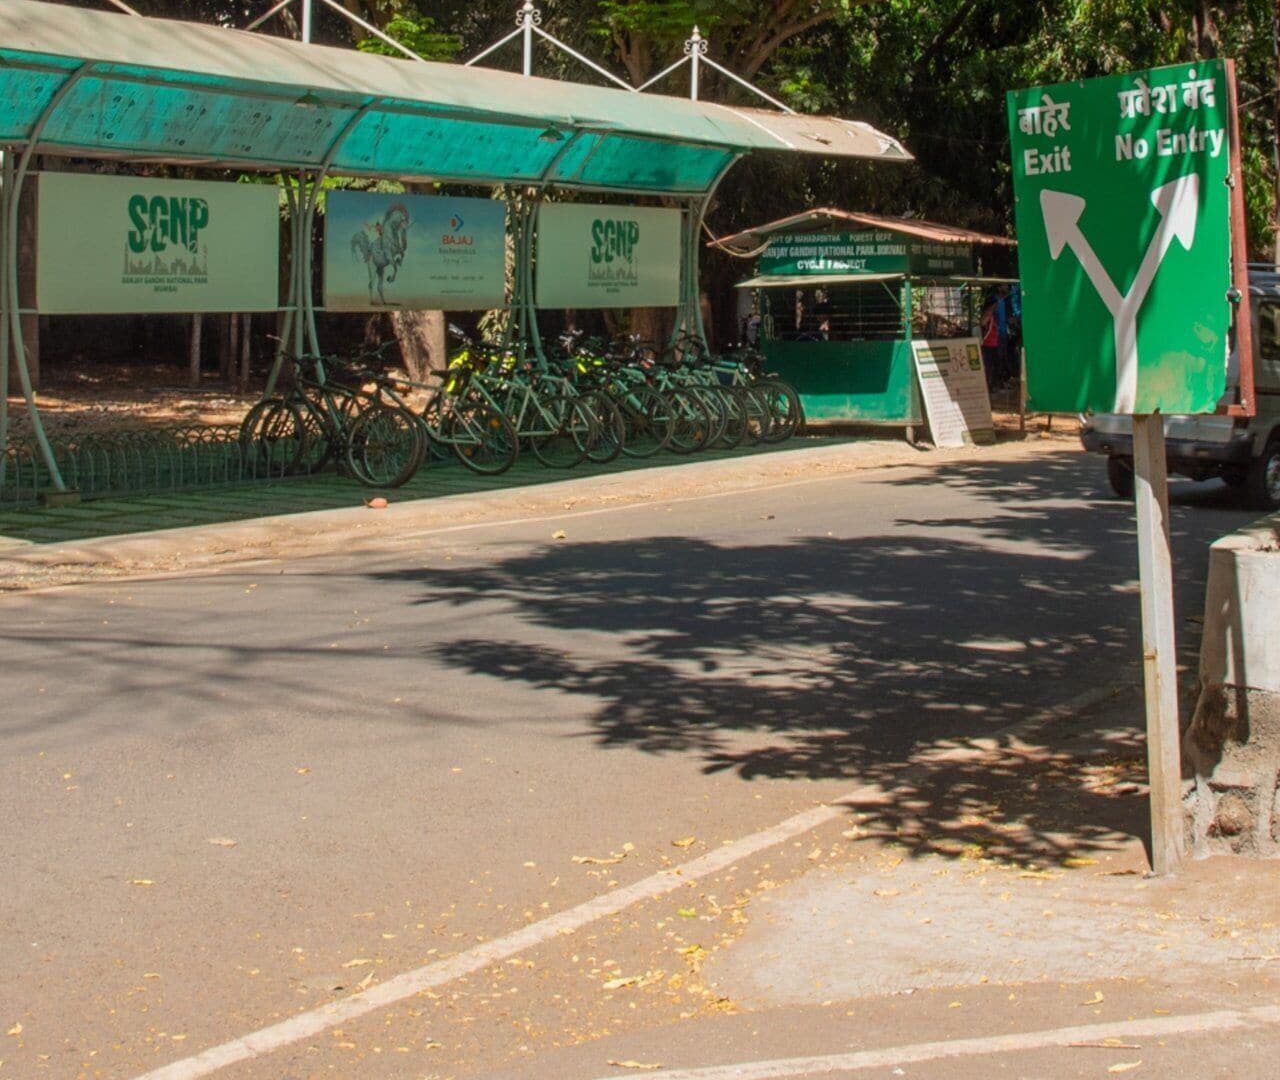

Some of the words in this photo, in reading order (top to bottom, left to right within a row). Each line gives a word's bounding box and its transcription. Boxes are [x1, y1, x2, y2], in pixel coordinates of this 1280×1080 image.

[1117, 77, 1177, 119] प्रवेश
[1181, 68, 1216, 110] बंद
[1018, 93, 1071, 138] बाहेर
[1023, 145, 1072, 176] Exit
[1115, 133, 1149, 161] No
[1156, 125, 1225, 159] Entry
[128, 194, 209, 255] SGNP
[441, 234, 473, 246] BAJAJ
[591, 219, 639, 264] SGNP
[796, 259, 825, 270] CYCLE
[827, 259, 866, 270] PROJECT
